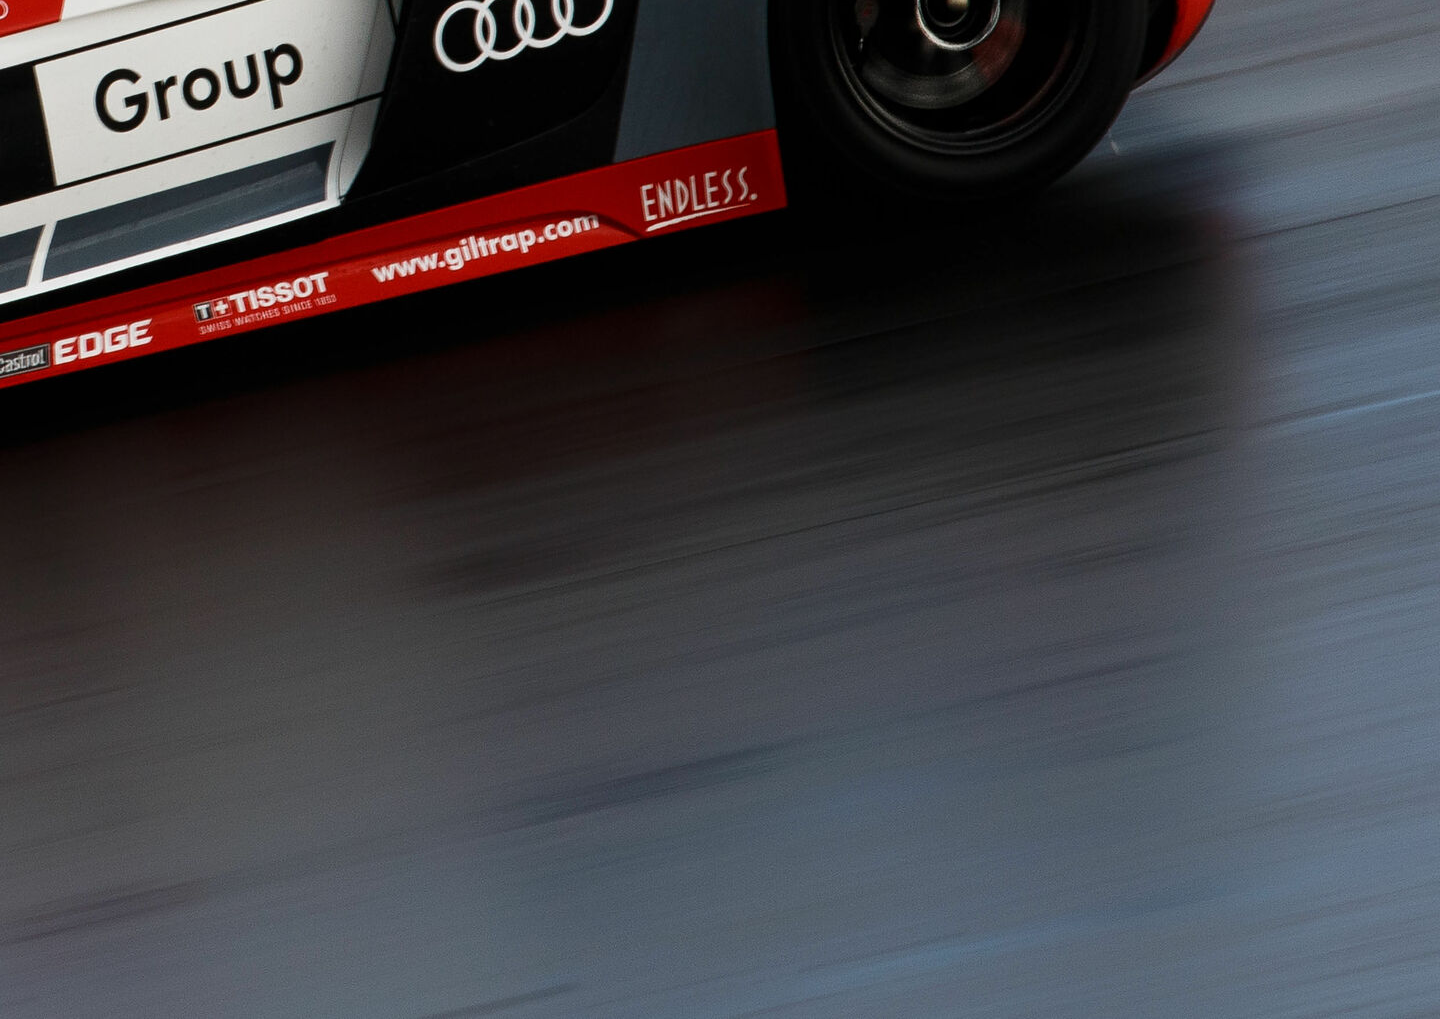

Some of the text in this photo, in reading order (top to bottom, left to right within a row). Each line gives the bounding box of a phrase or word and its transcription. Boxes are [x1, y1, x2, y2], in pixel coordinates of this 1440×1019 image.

[94, 41, 304, 134] Group
[371, 212, 600, 285] www.giltrap.com
[229, 271, 329, 314] TISSOT
[199, 318, 232, 336] SWISS
[233, 307, 281, 327] WATCHES
[282, 299, 314, 315] SINCE
[52, 318, 154, 366] EDGE
